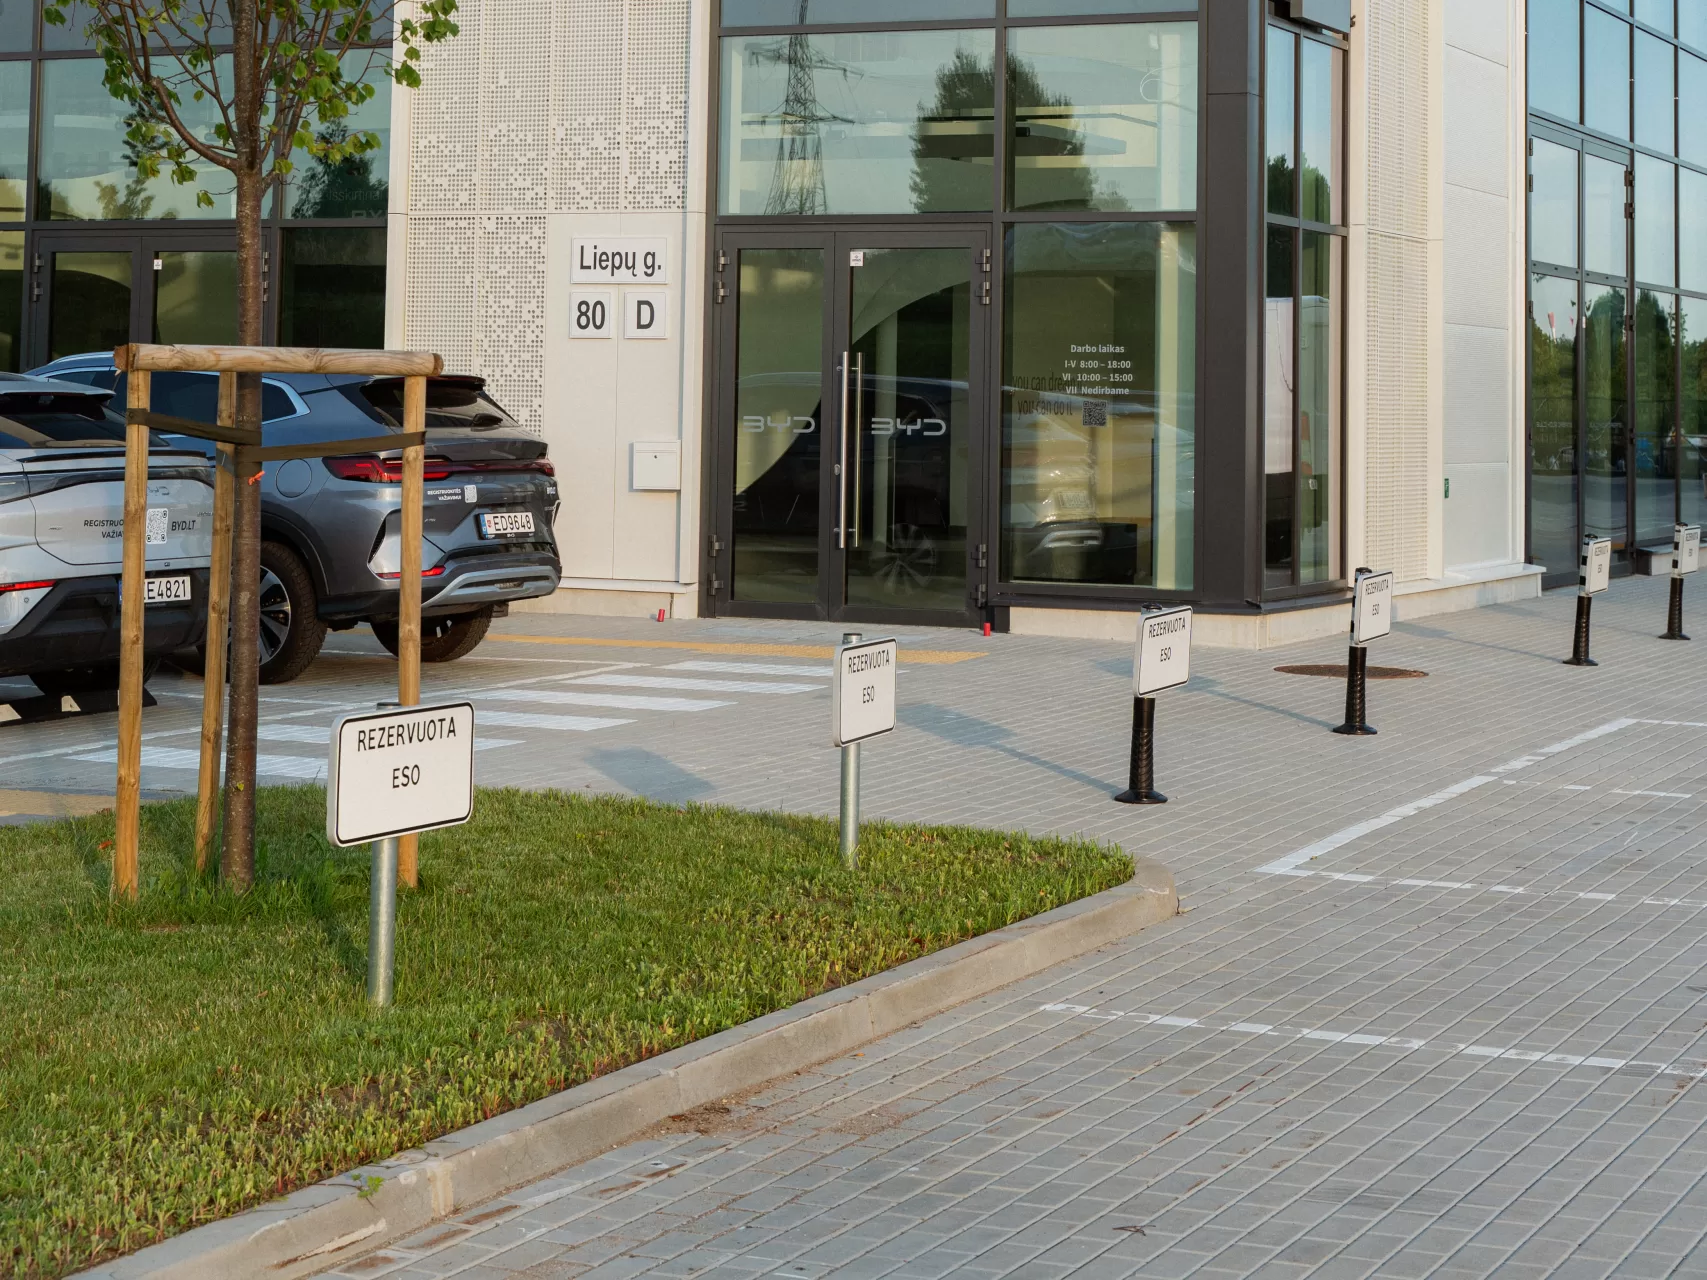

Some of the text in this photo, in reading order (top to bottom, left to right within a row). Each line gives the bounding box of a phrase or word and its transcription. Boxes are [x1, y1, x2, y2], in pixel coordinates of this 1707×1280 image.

[580, 245, 661, 277] Liepų g.
[576, 300, 605, 330] 80
[636, 300, 655, 330] D
[1070, 344, 1125, 353] Darbo laikas
[1064, 360, 1076, 368] I-V
[1079, 360, 1099, 368] 8:00
[1107, 360, 1131, 368] 18:00
[1062, 373, 1071, 381] VI
[1076, 373, 1100, 382] 10:00
[1109, 373, 1133, 382] 15:00
[1065, 386, 1077, 394] VII
[1081, 385, 1130, 395] Nedirbame
[1017, 400, 1034, 420] you
[742, 415, 816, 433] BYD
[871, 417, 946, 436] BYD
[84, 519, 124, 527] REGISTRUO
[171, 520, 196, 532] BYD.LT
[492, 514, 532, 532] ED9648
[144, 578, 187, 601] E4821
[1149, 617, 1186, 638] REZERVUOTA
[848, 649, 890, 674] REZERVUOTA
[1160, 646, 1172, 662] ESO
[862, 685, 875, 704] ESO
[357, 716, 457, 752] REZERVUOTA
[392, 764, 421, 789] ESO
